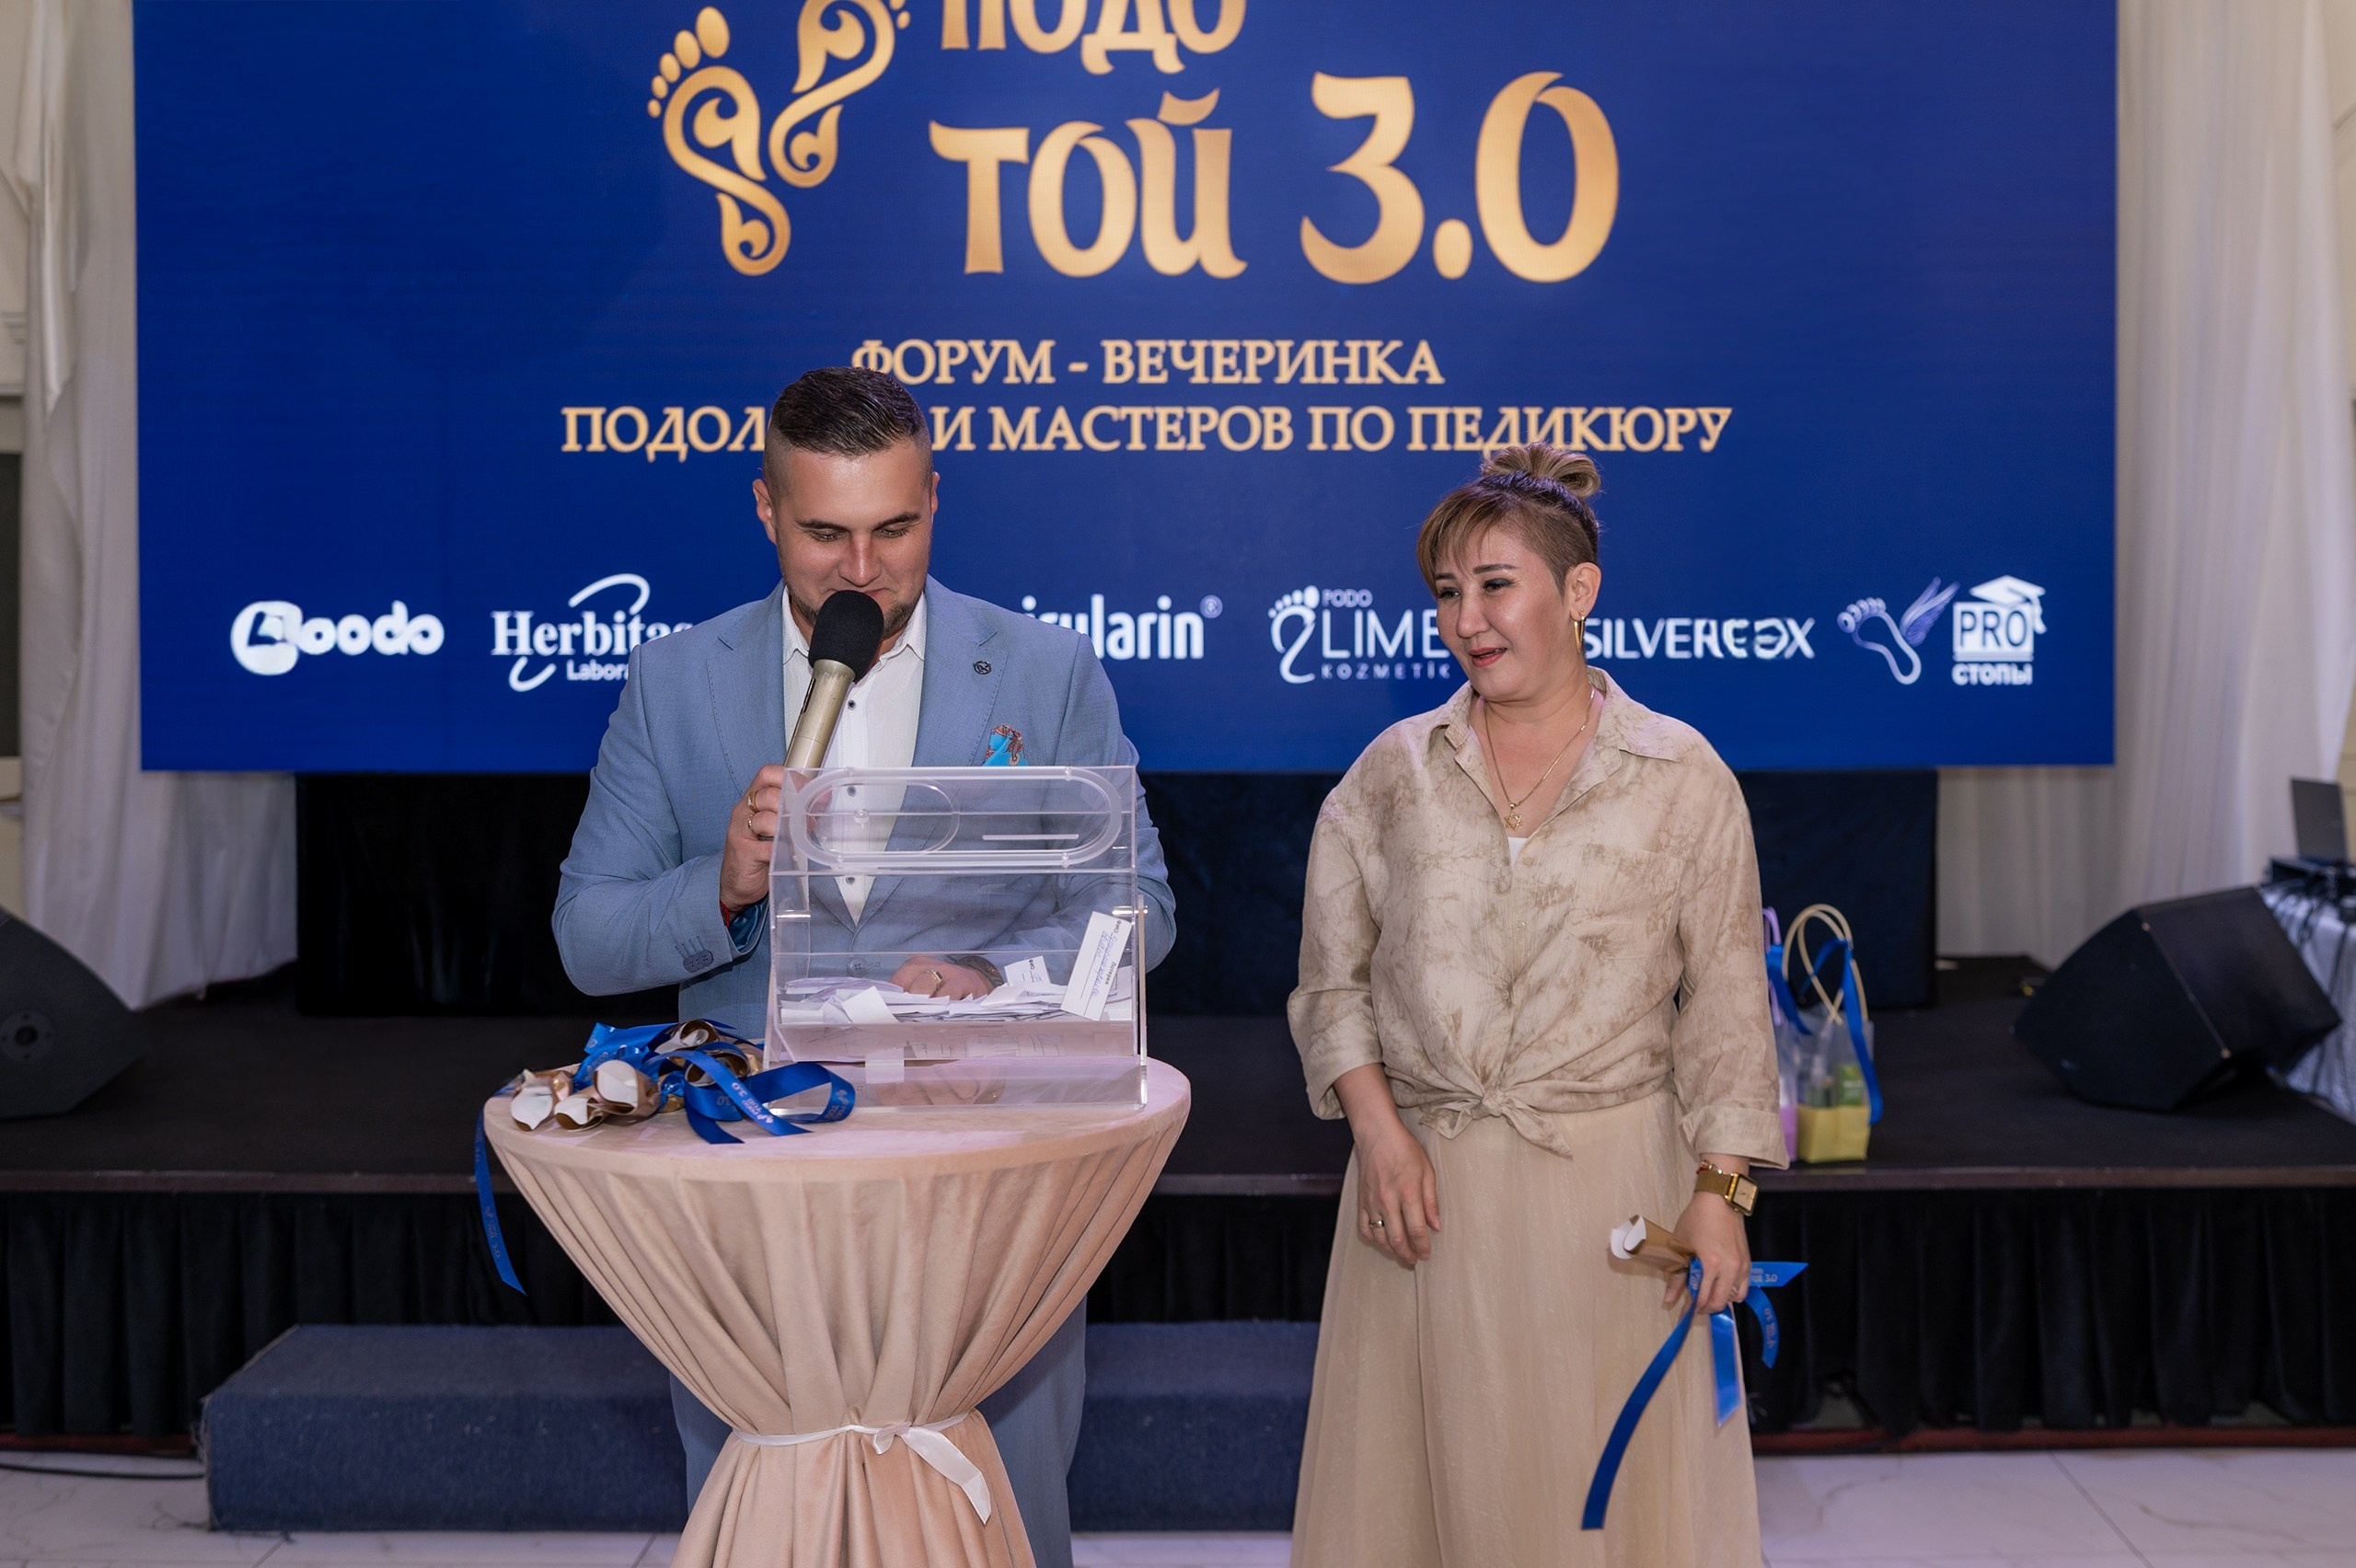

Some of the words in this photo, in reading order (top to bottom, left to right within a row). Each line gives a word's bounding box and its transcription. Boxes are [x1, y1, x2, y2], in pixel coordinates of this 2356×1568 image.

[1299, 71, 1620, 284] 3.0
[851, 339, 1056, 385] ФОРУМ
[1101, 339, 1445, 385] ВЕЧЕРИНКА
[560, 406, 766, 463] ПОДОЛ
[931, 406, 976, 451] И
[988, 405, 1294, 452] МАСТЕРОВ
[1307, 405, 1395, 452] ПО
[1406, 405, 1733, 460] ПЕДИКЮРУ
[1322, 588, 1374, 607] PODO
[491, 609, 693, 656] Herbit
[1322, 608, 1450, 659] LIME
[1960, 610, 2027, 647] PRO
